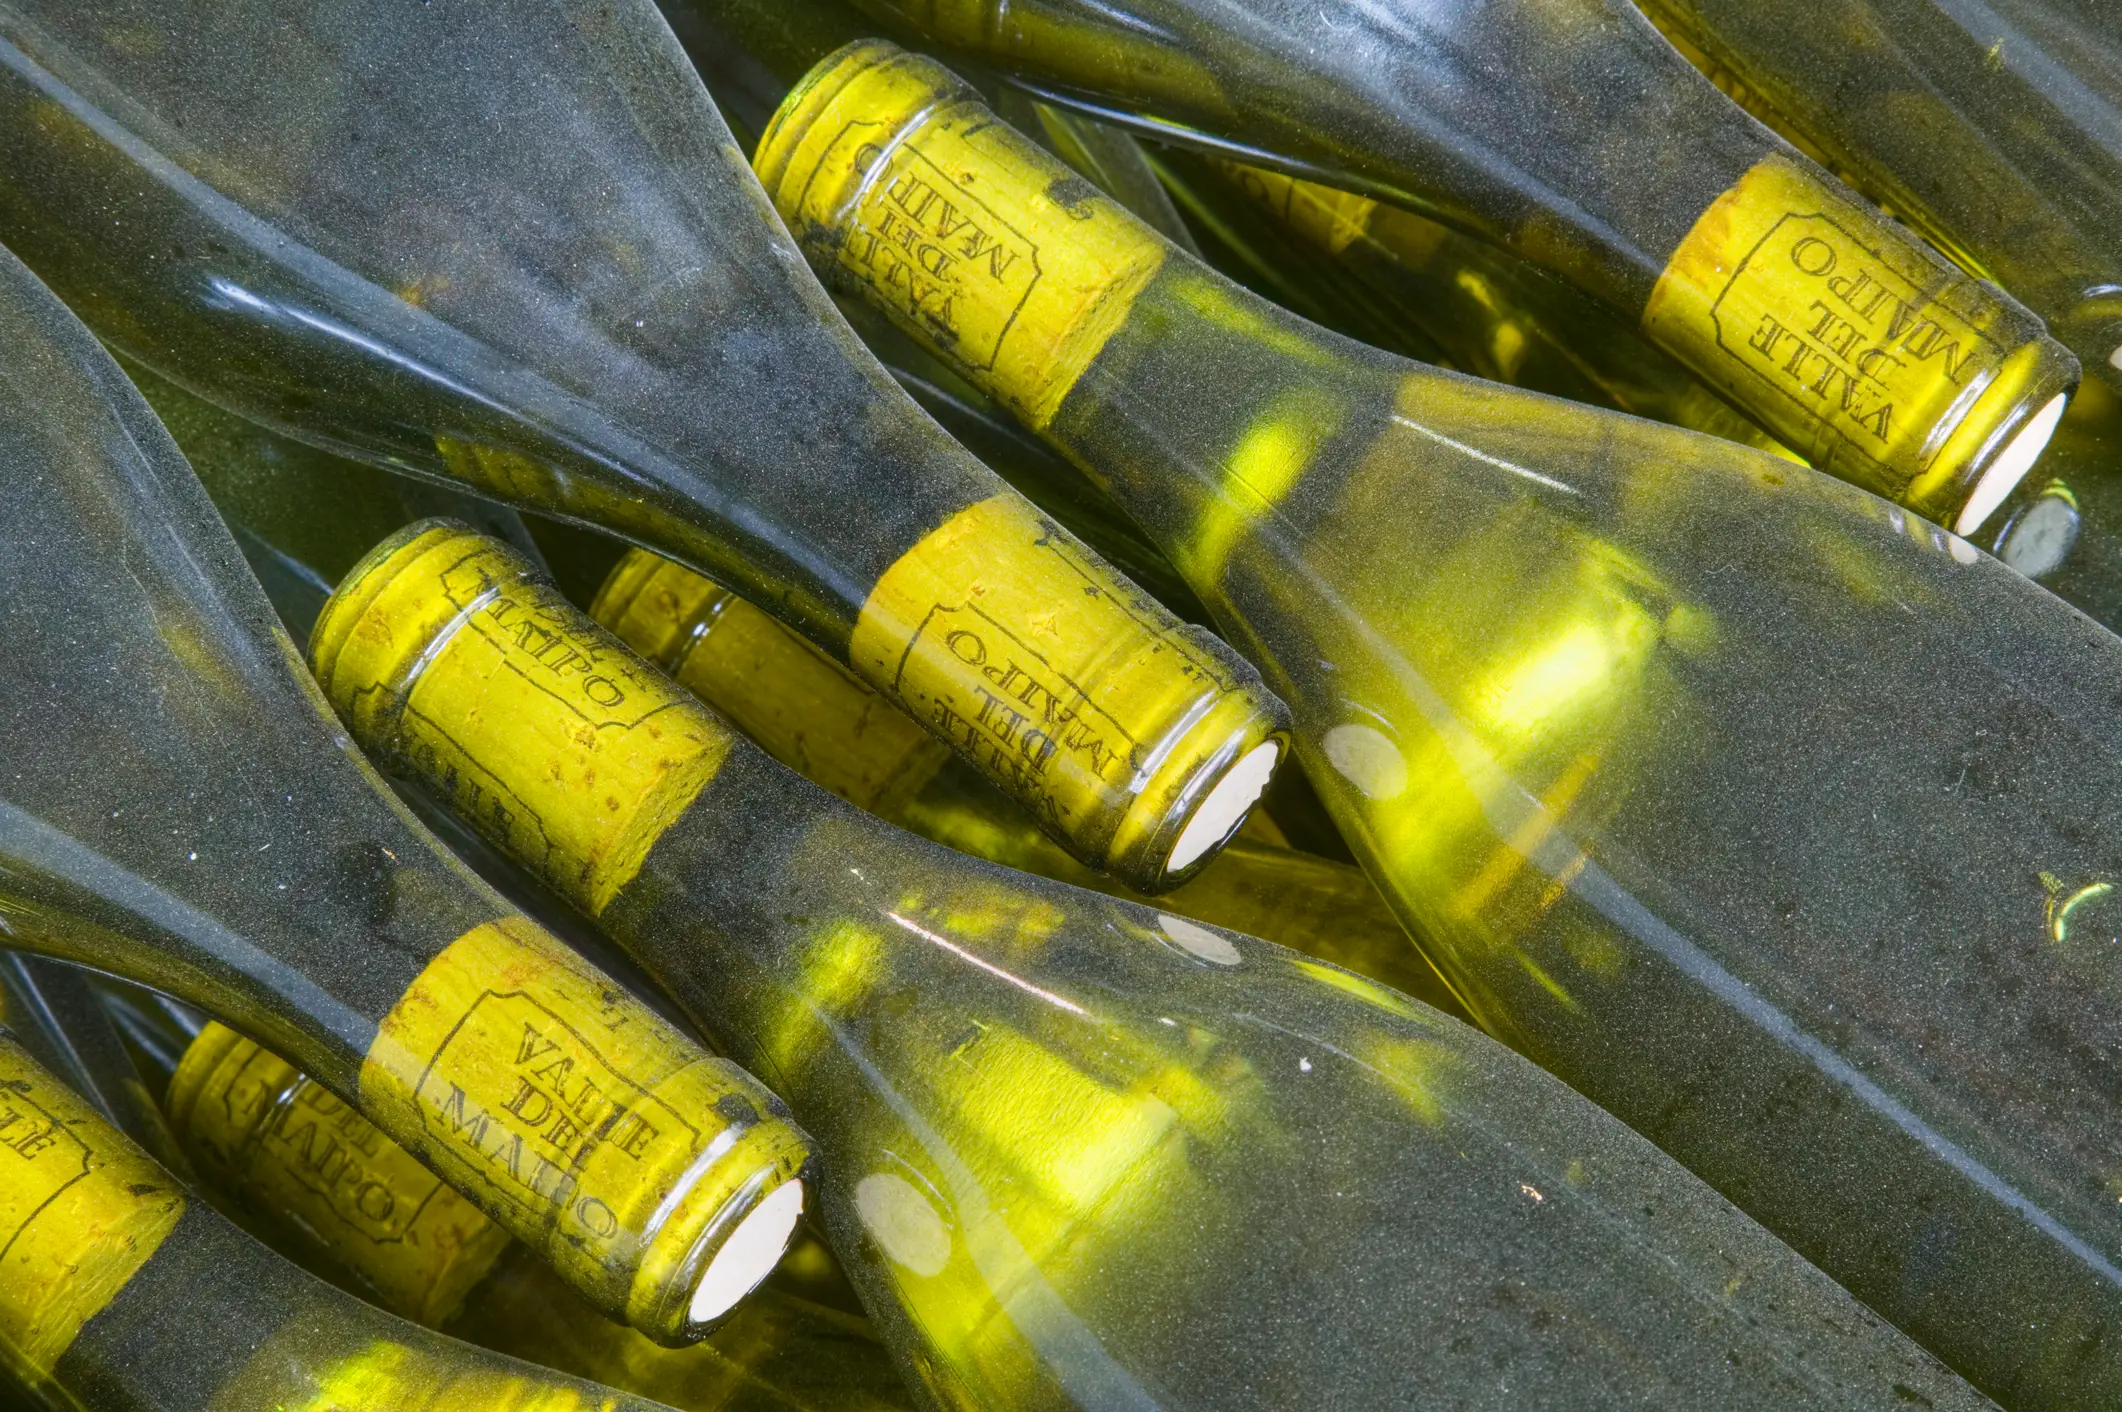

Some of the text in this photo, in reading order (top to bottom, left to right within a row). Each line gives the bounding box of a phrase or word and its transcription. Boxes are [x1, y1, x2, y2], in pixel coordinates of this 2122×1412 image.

[854, 142, 1022, 285] MAIPO
[876, 201, 960, 284] DEL
[1748, 312, 1895, 445] VALLE
[1790, 236, 1979, 387] MAIPO
[1806, 299, 1908, 392] DEL
[462, 566, 626, 708] MAIPO
[945, 629, 1121, 782] MAIPO
[973, 684, 1059, 778] DEL
[242, 1079, 395, 1222] MAIPO
[432, 1080, 619, 1240] MAIPO
[500, 1075, 599, 1174] DEL
[514, 1021, 660, 1162] VALLE
